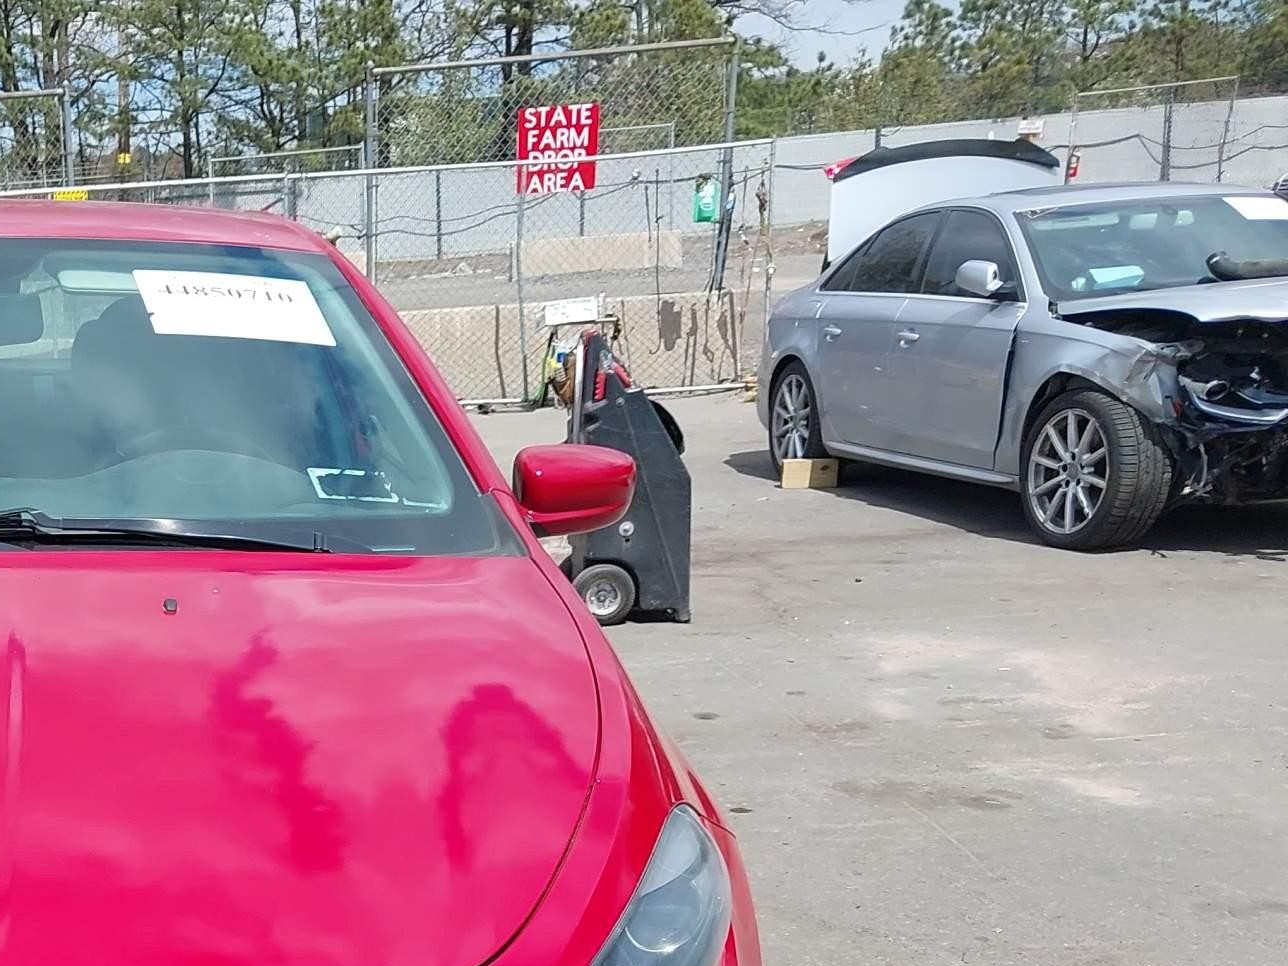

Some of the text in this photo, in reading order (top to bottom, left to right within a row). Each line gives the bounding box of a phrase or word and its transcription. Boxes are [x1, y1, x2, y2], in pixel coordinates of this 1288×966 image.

[524, 103, 593, 128] STATE
[527, 126, 589, 151] FARM
[528, 148, 587, 172] DROP
[526, 171, 585, 194] AREA
